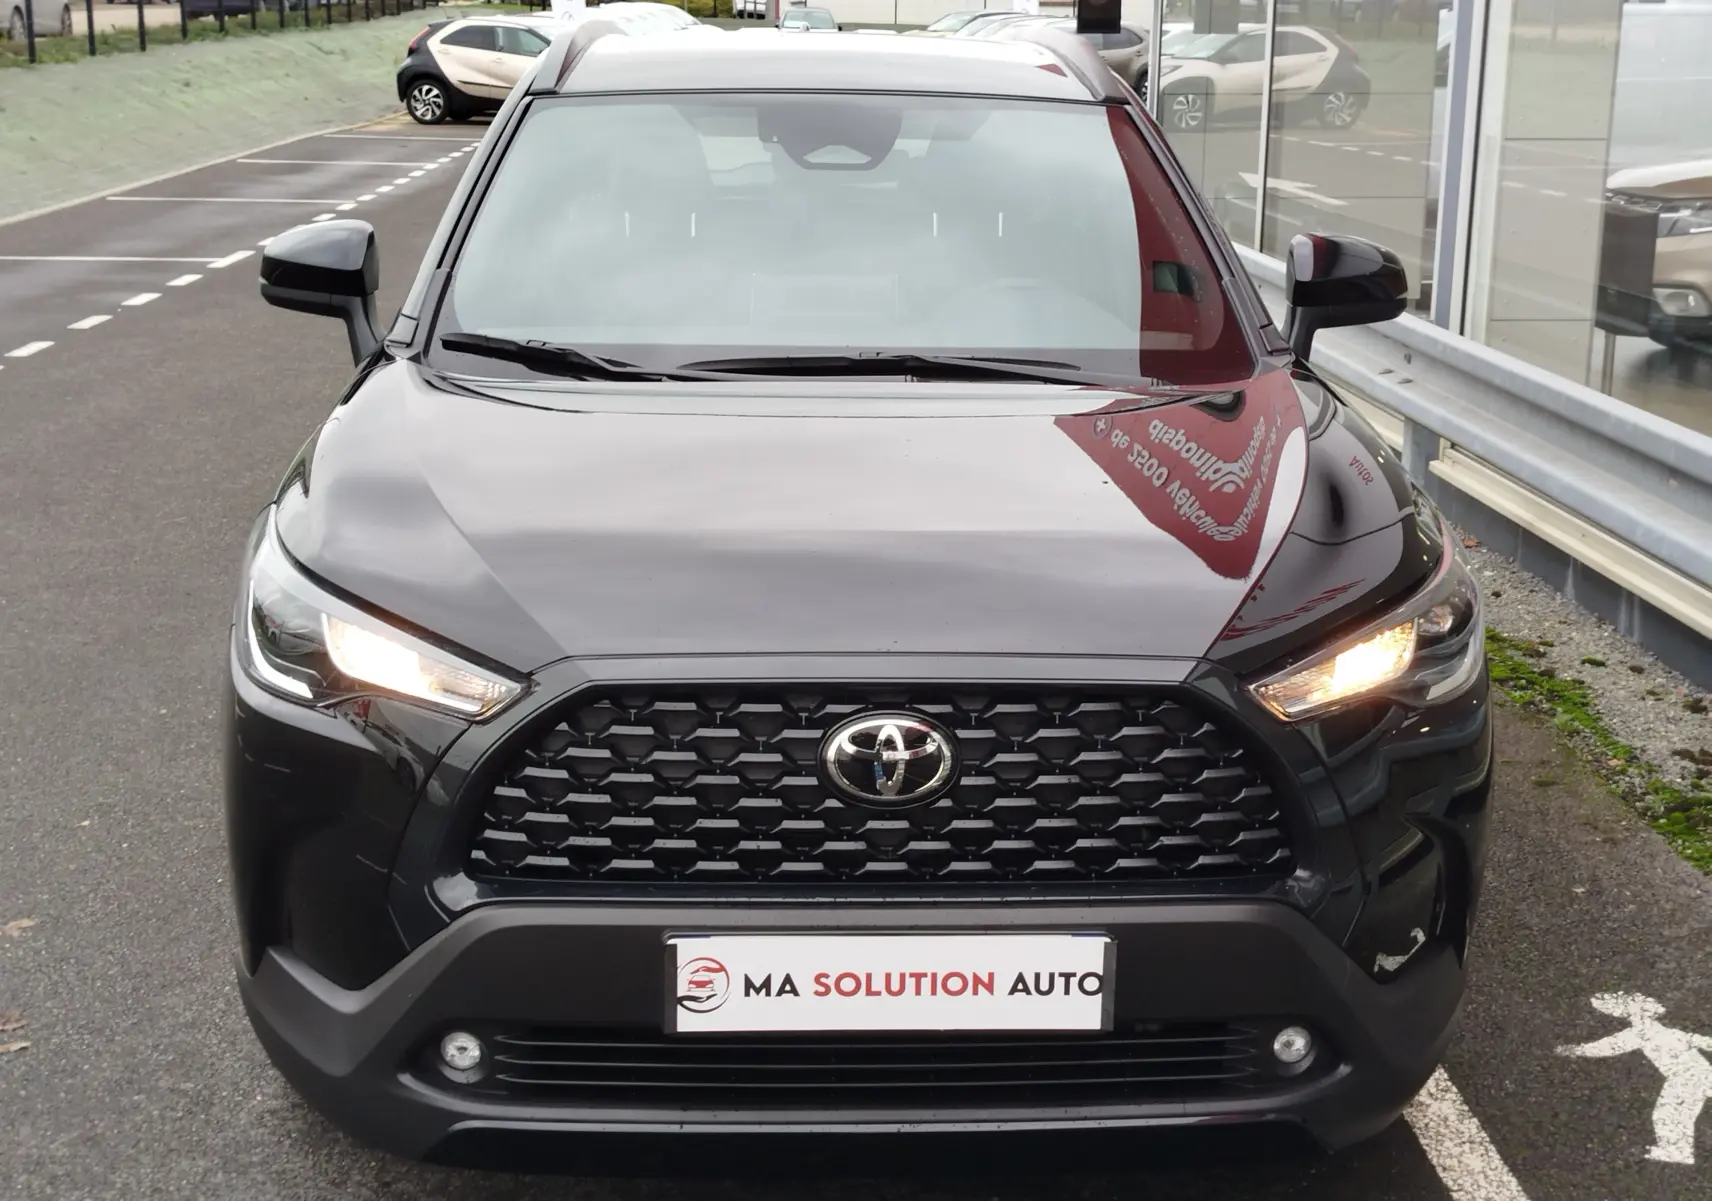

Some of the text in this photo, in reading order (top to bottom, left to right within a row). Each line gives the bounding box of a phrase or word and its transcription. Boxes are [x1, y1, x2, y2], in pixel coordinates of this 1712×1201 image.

[743, 971, 1103, 998] MA SOLUTION AUTO
